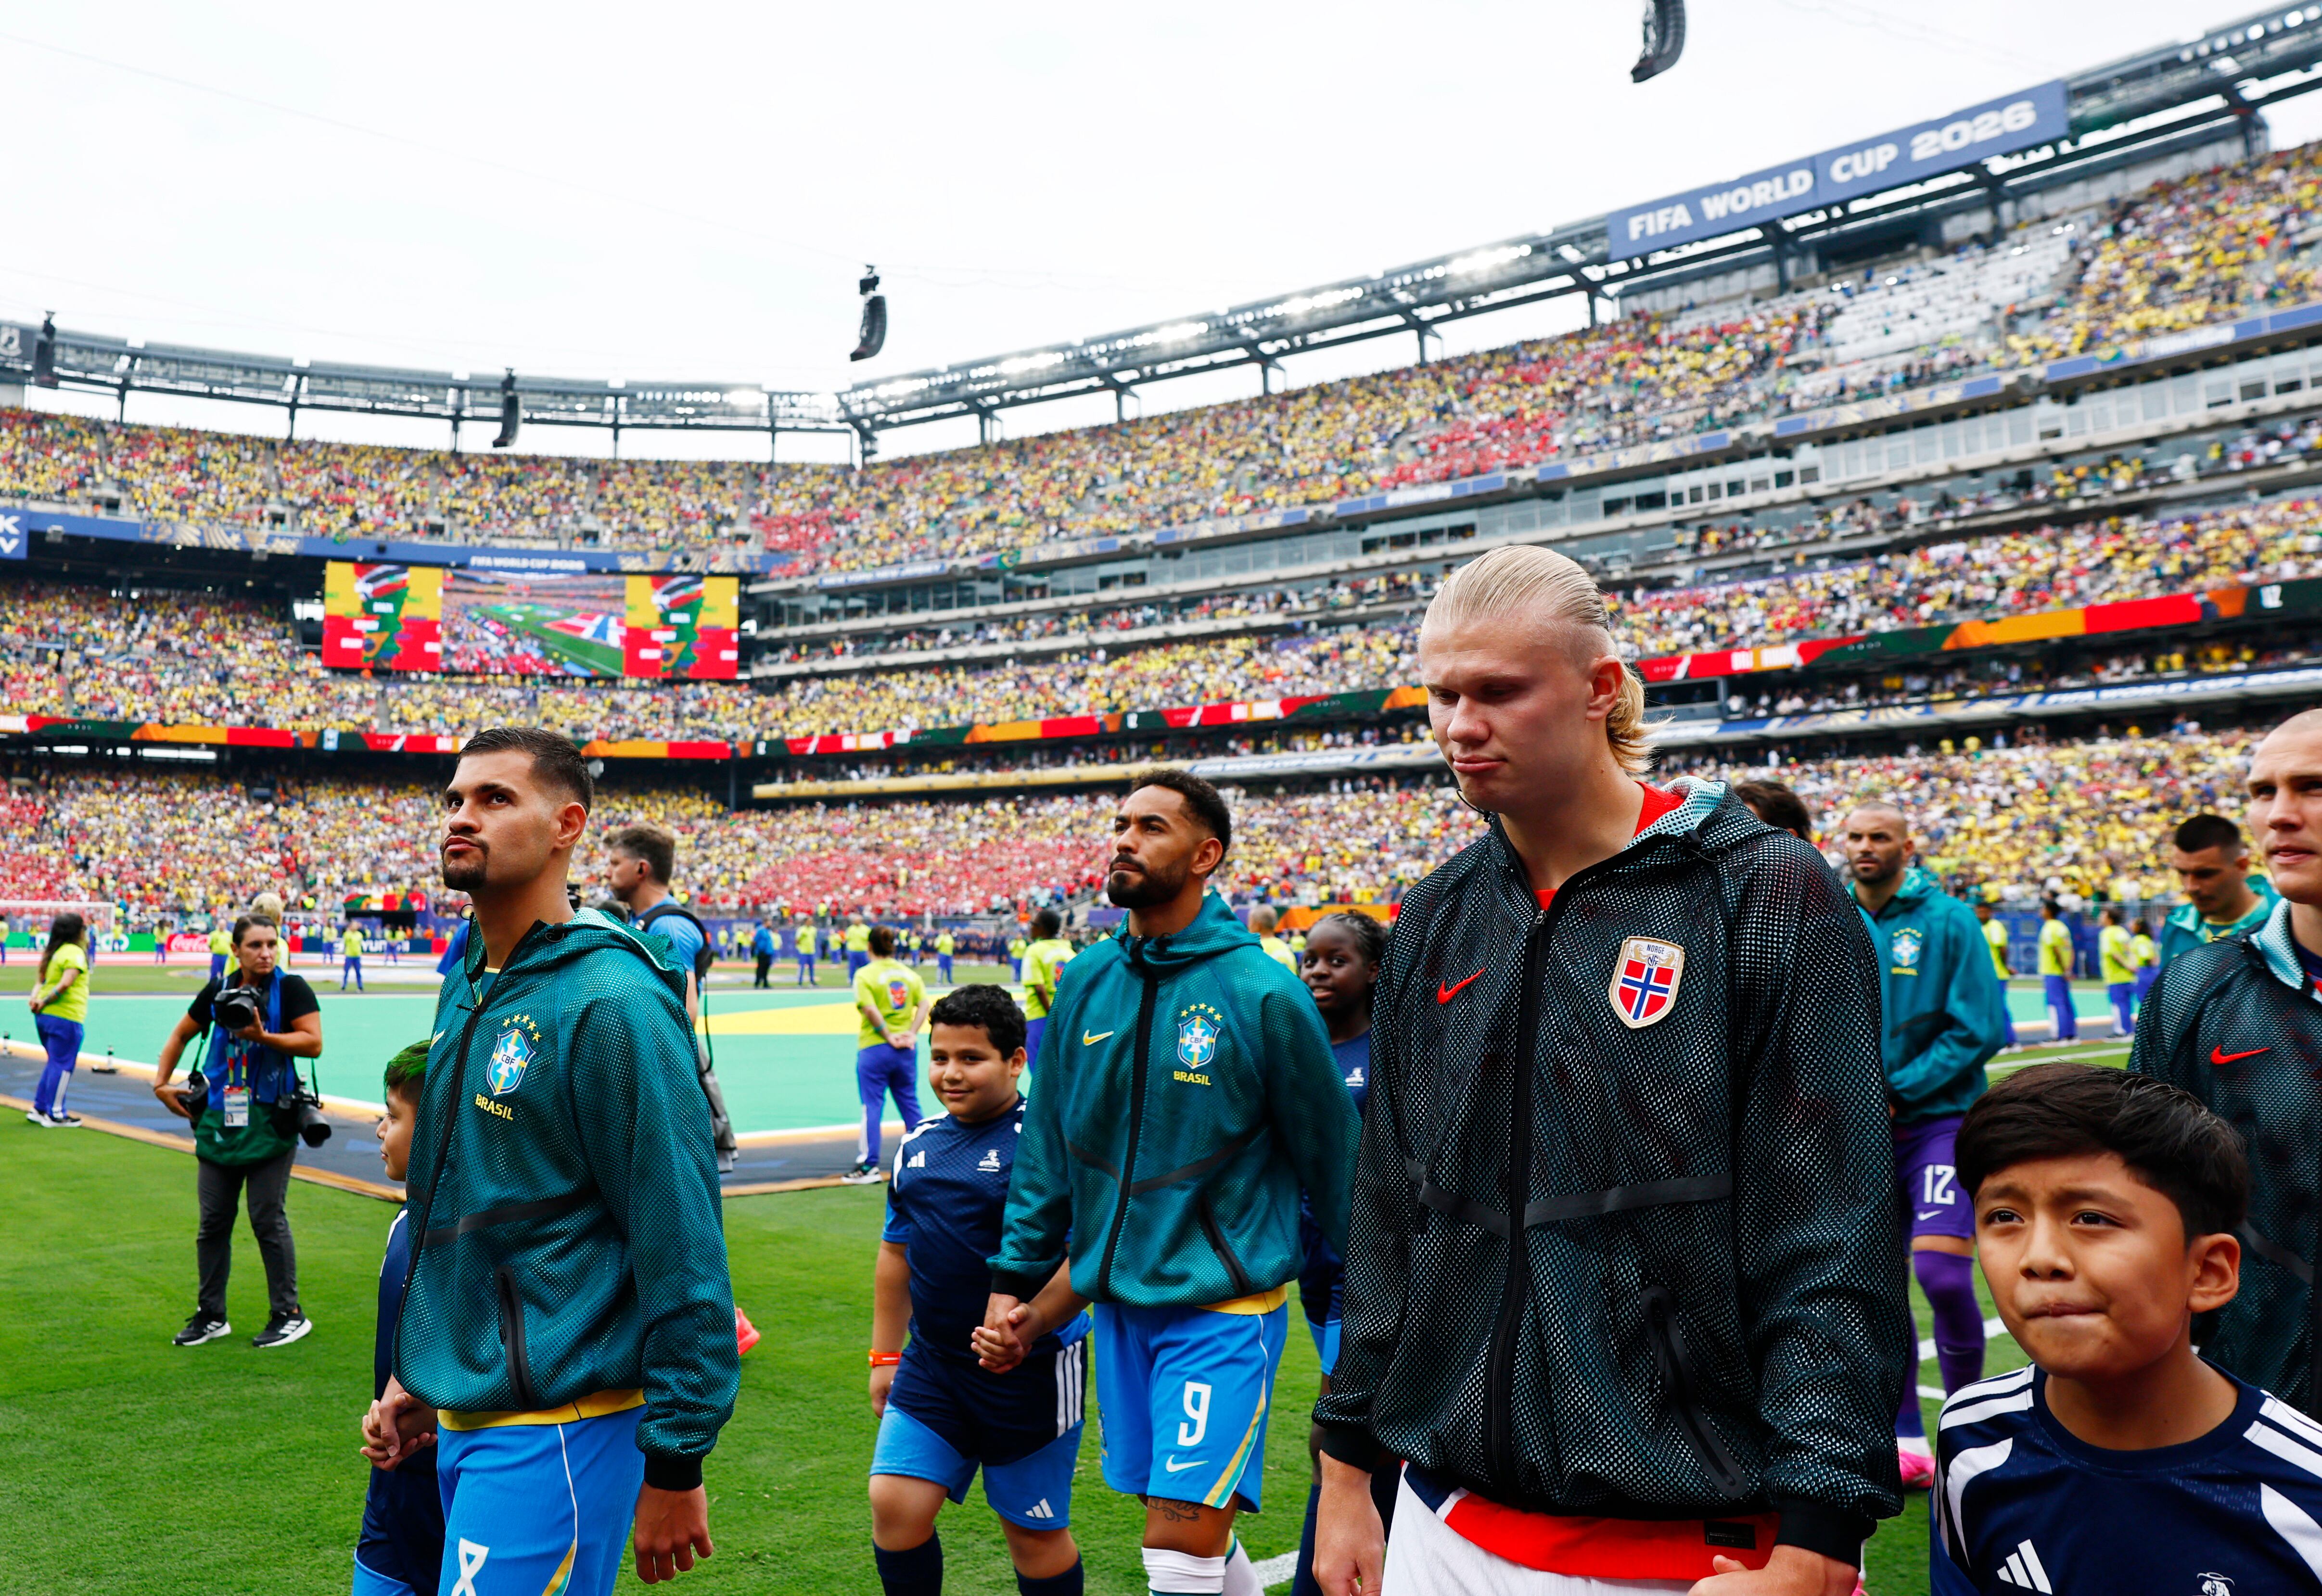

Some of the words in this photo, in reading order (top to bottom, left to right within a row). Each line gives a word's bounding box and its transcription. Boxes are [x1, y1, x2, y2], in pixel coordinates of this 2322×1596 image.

[1628, 201, 1693, 241] FIFA
[1700, 168, 1814, 221] WORLD
[1829, 142, 1899, 184] CUP
[1910, 100, 2037, 162] 2026
[470, 556, 493, 567] FIFA
[494, 557, 529, 569] WORLD
[530, 558, 550, 570] CUP
[550, 559, 586, 571] 2026
[1646, 944, 1665, 954] NORGE
[1190, 1037, 1204, 1045] CBF
[501, 1054, 516, 1065] CBF
[1173, 1070, 1212, 1086] BRASIL
[475, 1093, 513, 1121] BRASIL
[1923, 1164, 1956, 1205] 12
[1177, 1381, 1212, 1447] 9
[451, 1537, 490, 1596] 8
